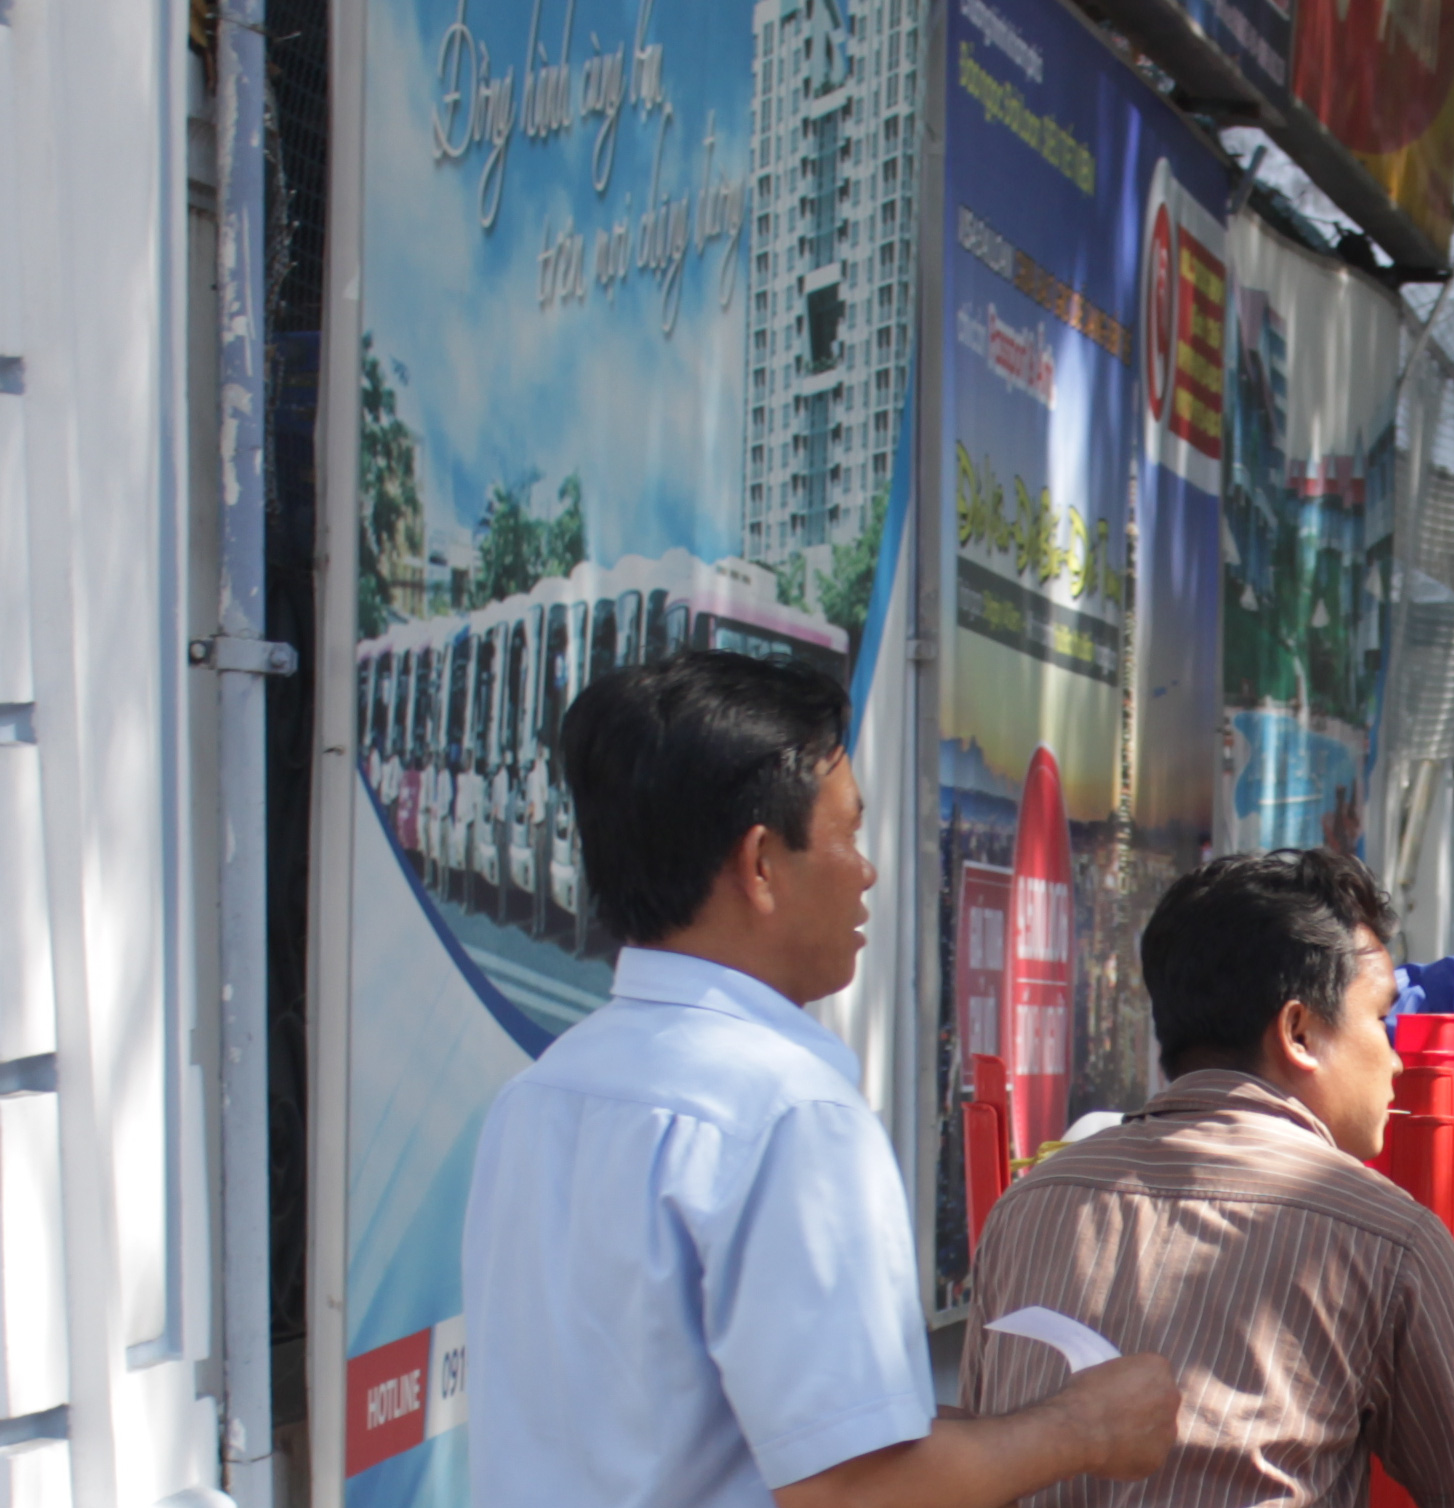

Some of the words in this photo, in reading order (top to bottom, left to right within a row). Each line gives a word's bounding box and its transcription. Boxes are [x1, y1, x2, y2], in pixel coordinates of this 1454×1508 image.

[580, 30, 625, 191] cùng
[366, 1368, 422, 1431] HOTLINE
[442, 1345, 467, 1399] 091
